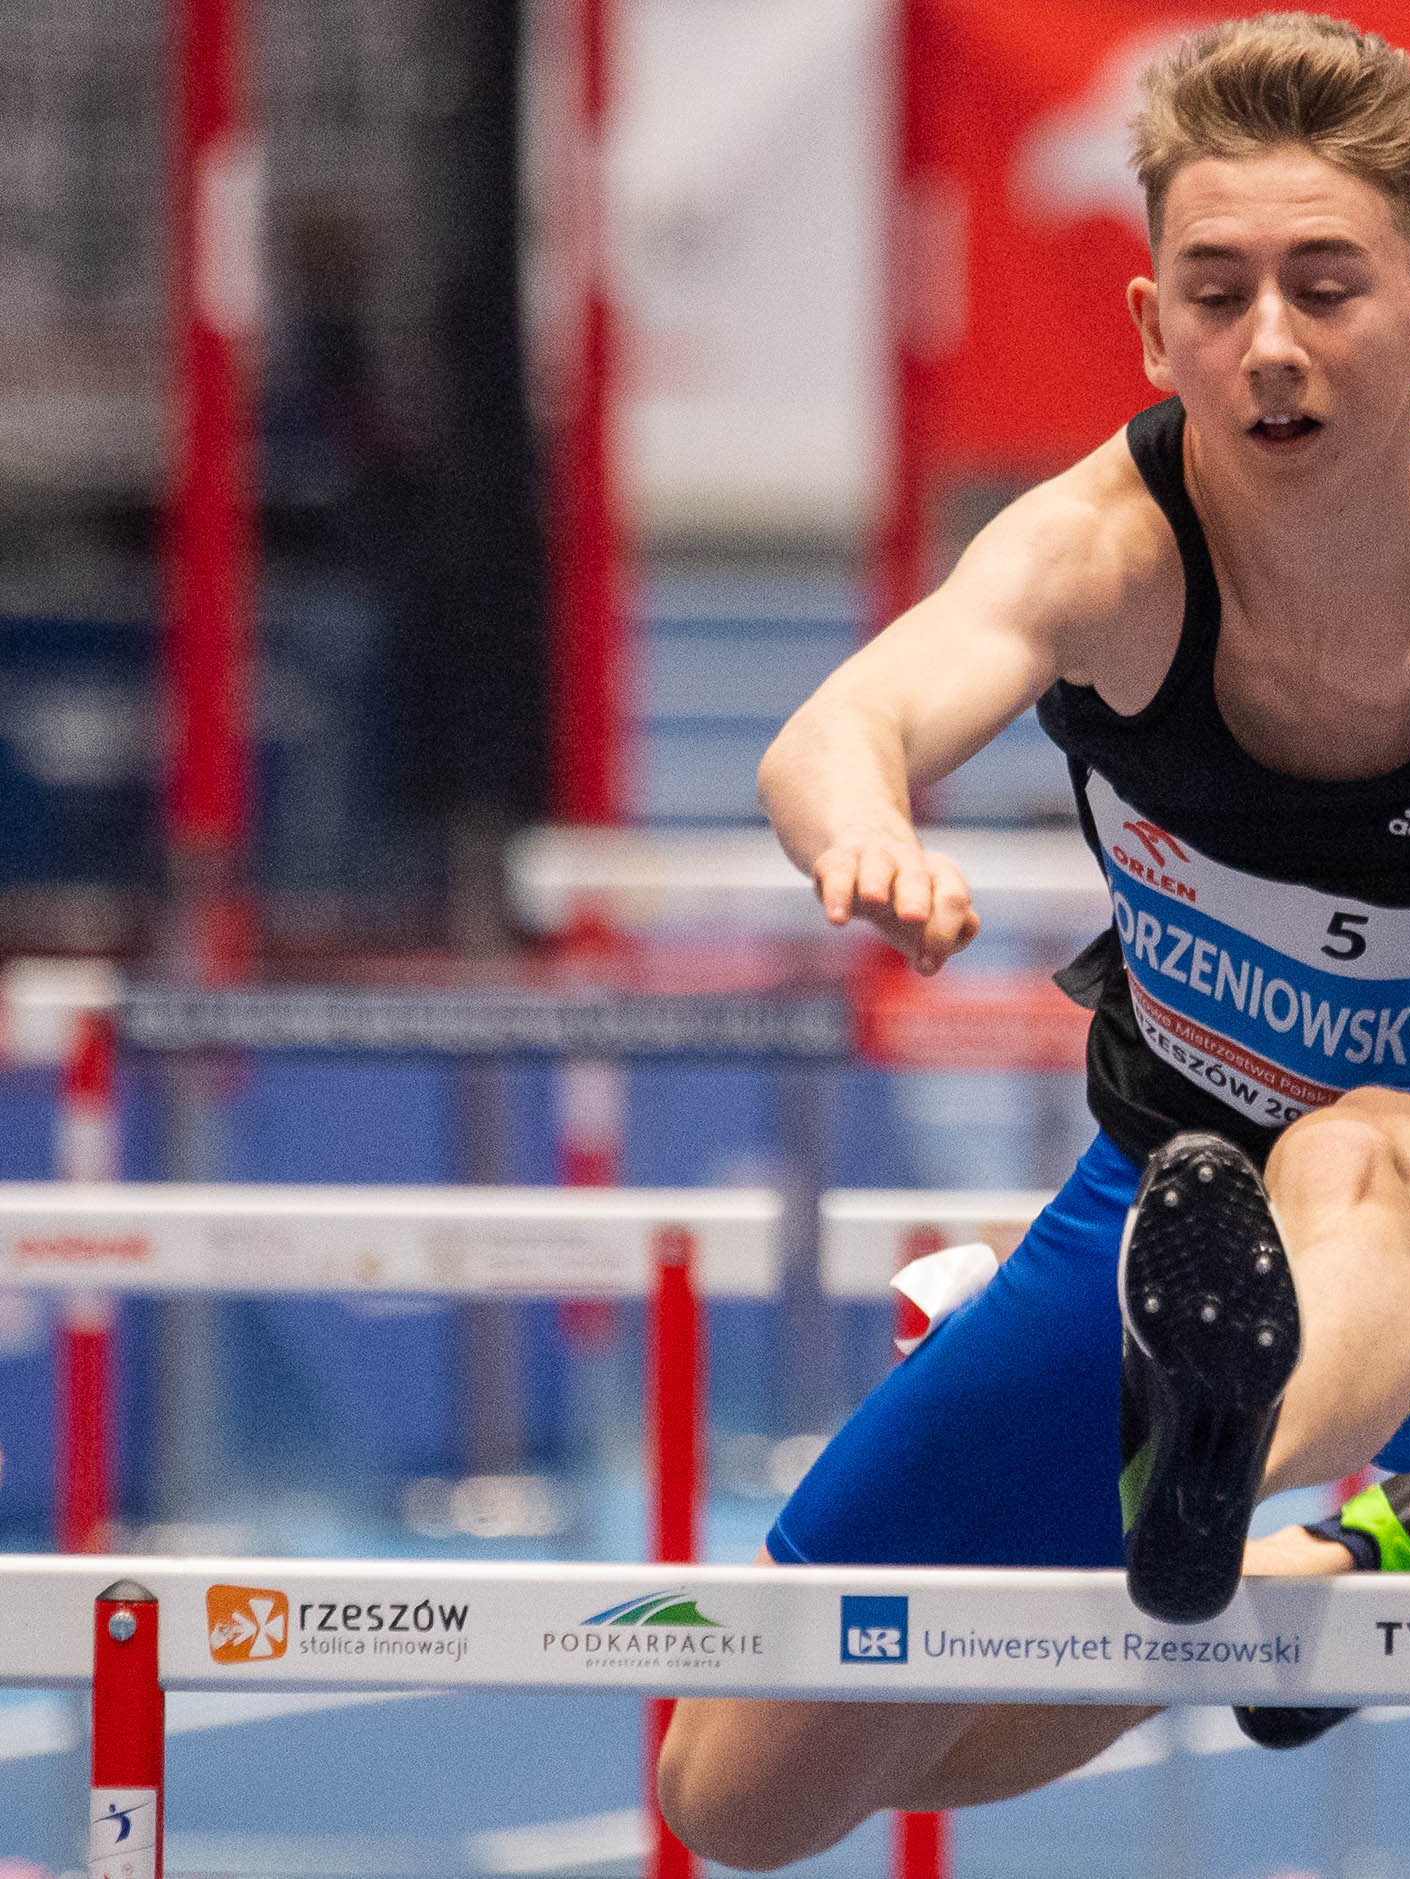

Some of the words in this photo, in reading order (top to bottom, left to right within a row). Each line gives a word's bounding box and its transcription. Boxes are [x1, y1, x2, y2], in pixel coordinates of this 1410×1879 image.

[1112, 845, 1197, 902] ORLEN
[1321, 911, 1370, 960] 5
[1174, 1021, 1276, 1084] Mistrzostwa
[299, 1599, 469, 1633] rzeszów
[299, 1636, 365, 1656] stolica
[373, 1637, 469, 1663] innowacji
[543, 1633, 763, 1655] PODKARPACKIE
[923, 1629, 1113, 1667] Uniwersytet
[1123, 1633, 1301, 1665] Rzeszowski
